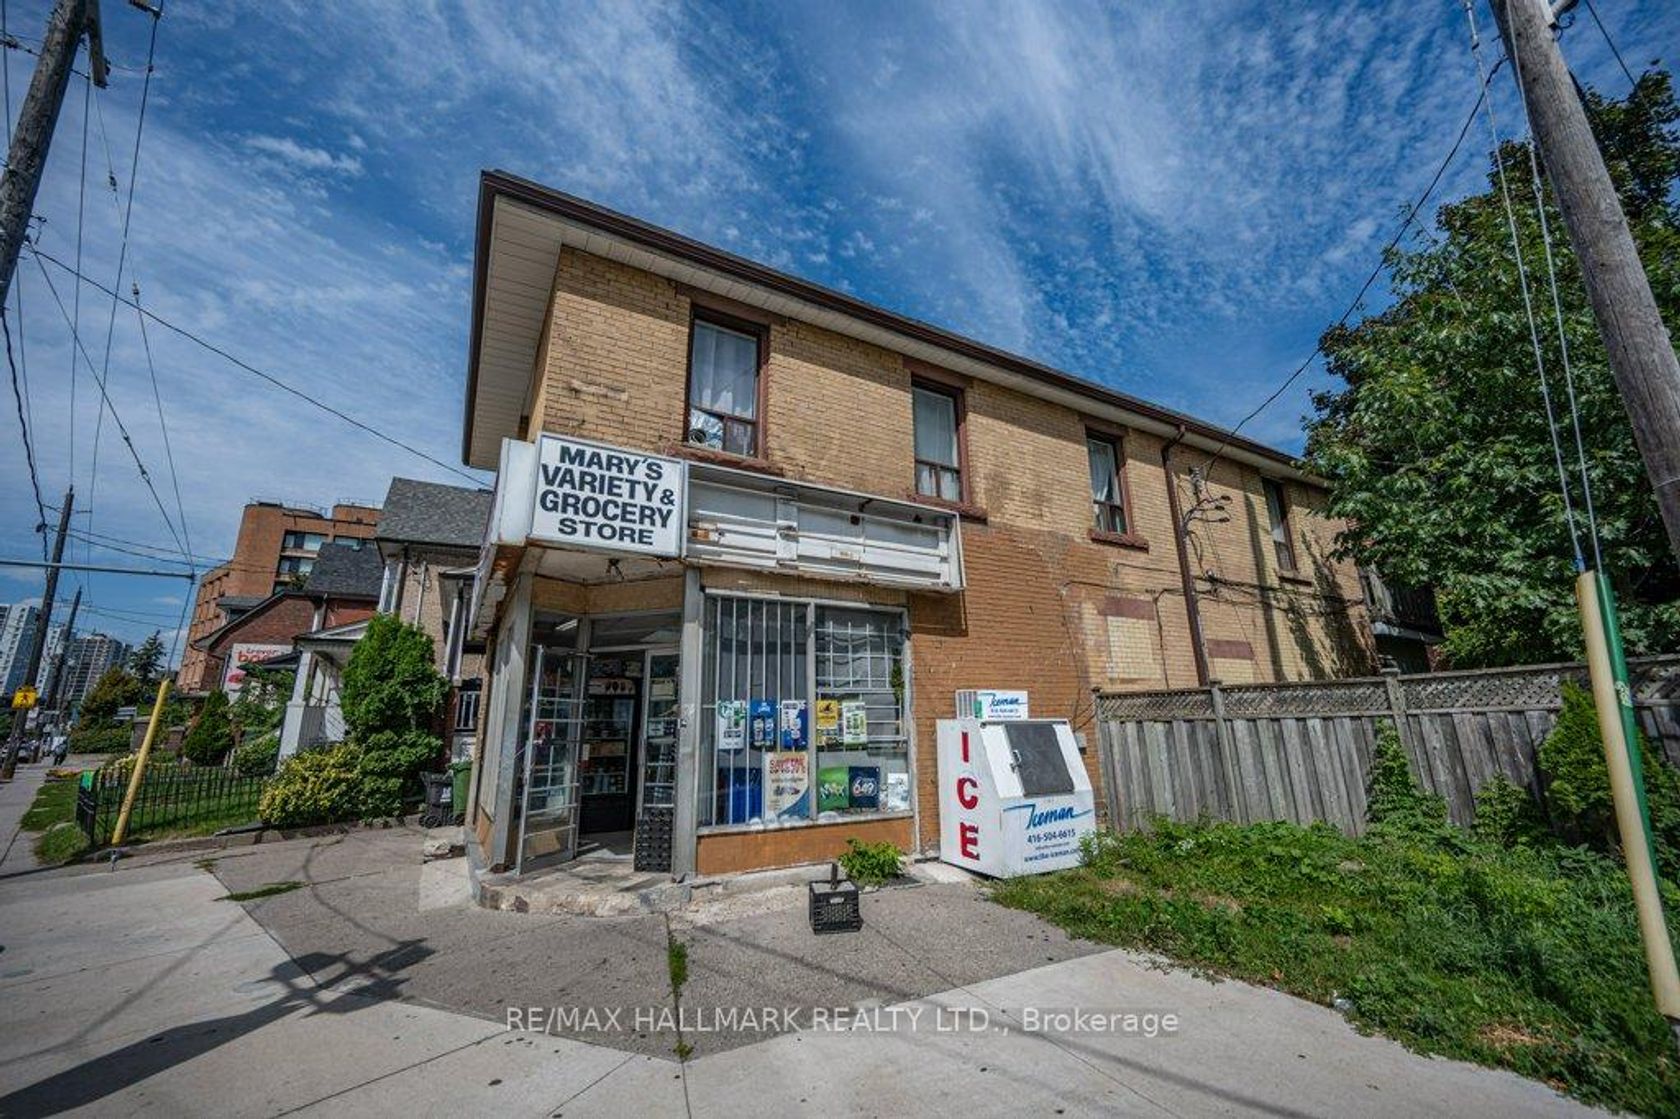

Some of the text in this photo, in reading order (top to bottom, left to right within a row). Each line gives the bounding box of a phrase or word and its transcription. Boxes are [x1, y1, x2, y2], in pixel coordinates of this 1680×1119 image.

[559, 444, 664, 482] MARY'S
[541, 463, 676, 507] VARIETY &
[539, 488, 674, 529] GROCERY
[557, 517, 655, 546] STORE
[956, 731, 981, 861] ICE
[1002, 803, 1094, 830] Iceman
